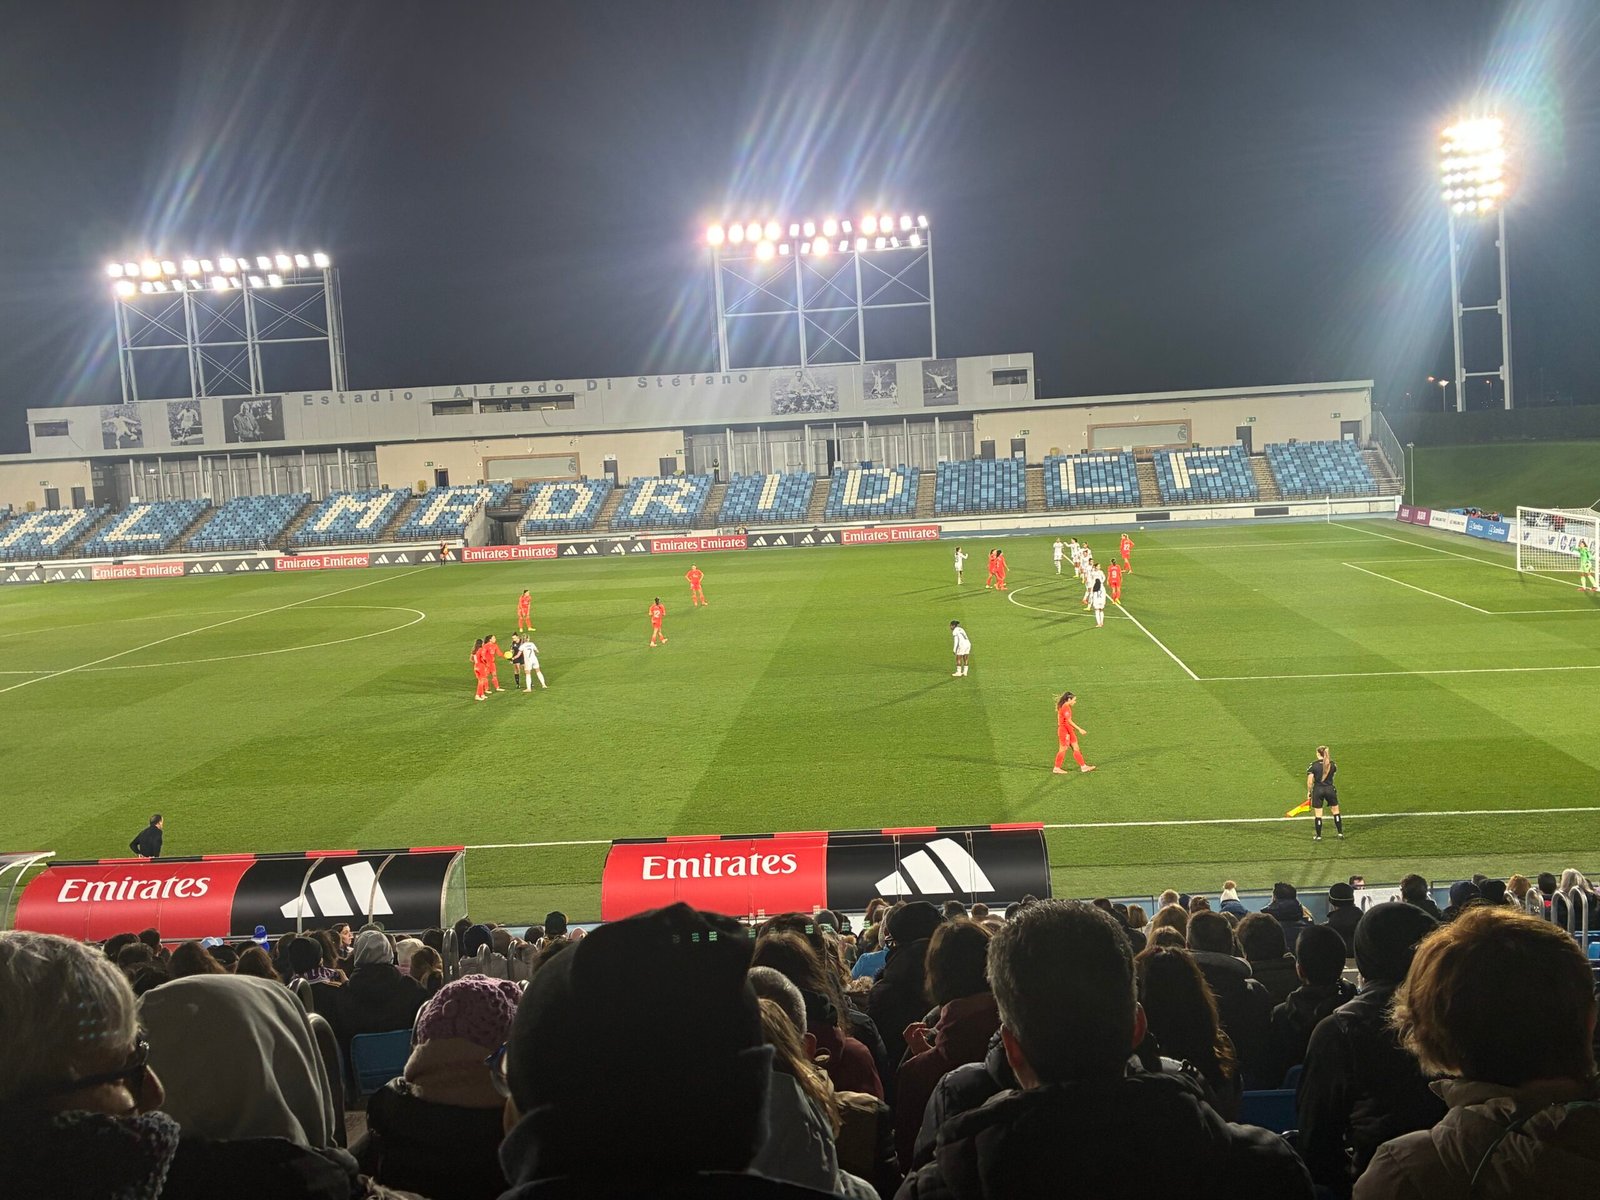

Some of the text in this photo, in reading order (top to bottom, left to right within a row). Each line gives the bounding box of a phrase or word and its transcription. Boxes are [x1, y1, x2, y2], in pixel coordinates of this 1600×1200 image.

[303, 374, 748, 406] Estadio Alfredo Di Stéfano
[843, 529, 937, 542] Emirates Emirates
[653, 537, 745, 551] Emirates Emirates
[464, 545, 556, 560] Emirates Emirates
[277, 556, 368, 570] Emirates Emirates
[94, 564, 183, 579] Emirates Emirates
[527, 648, 533, 658] 7
[642, 852, 797, 881] Emirates
[57, 876, 211, 903] Emirates
